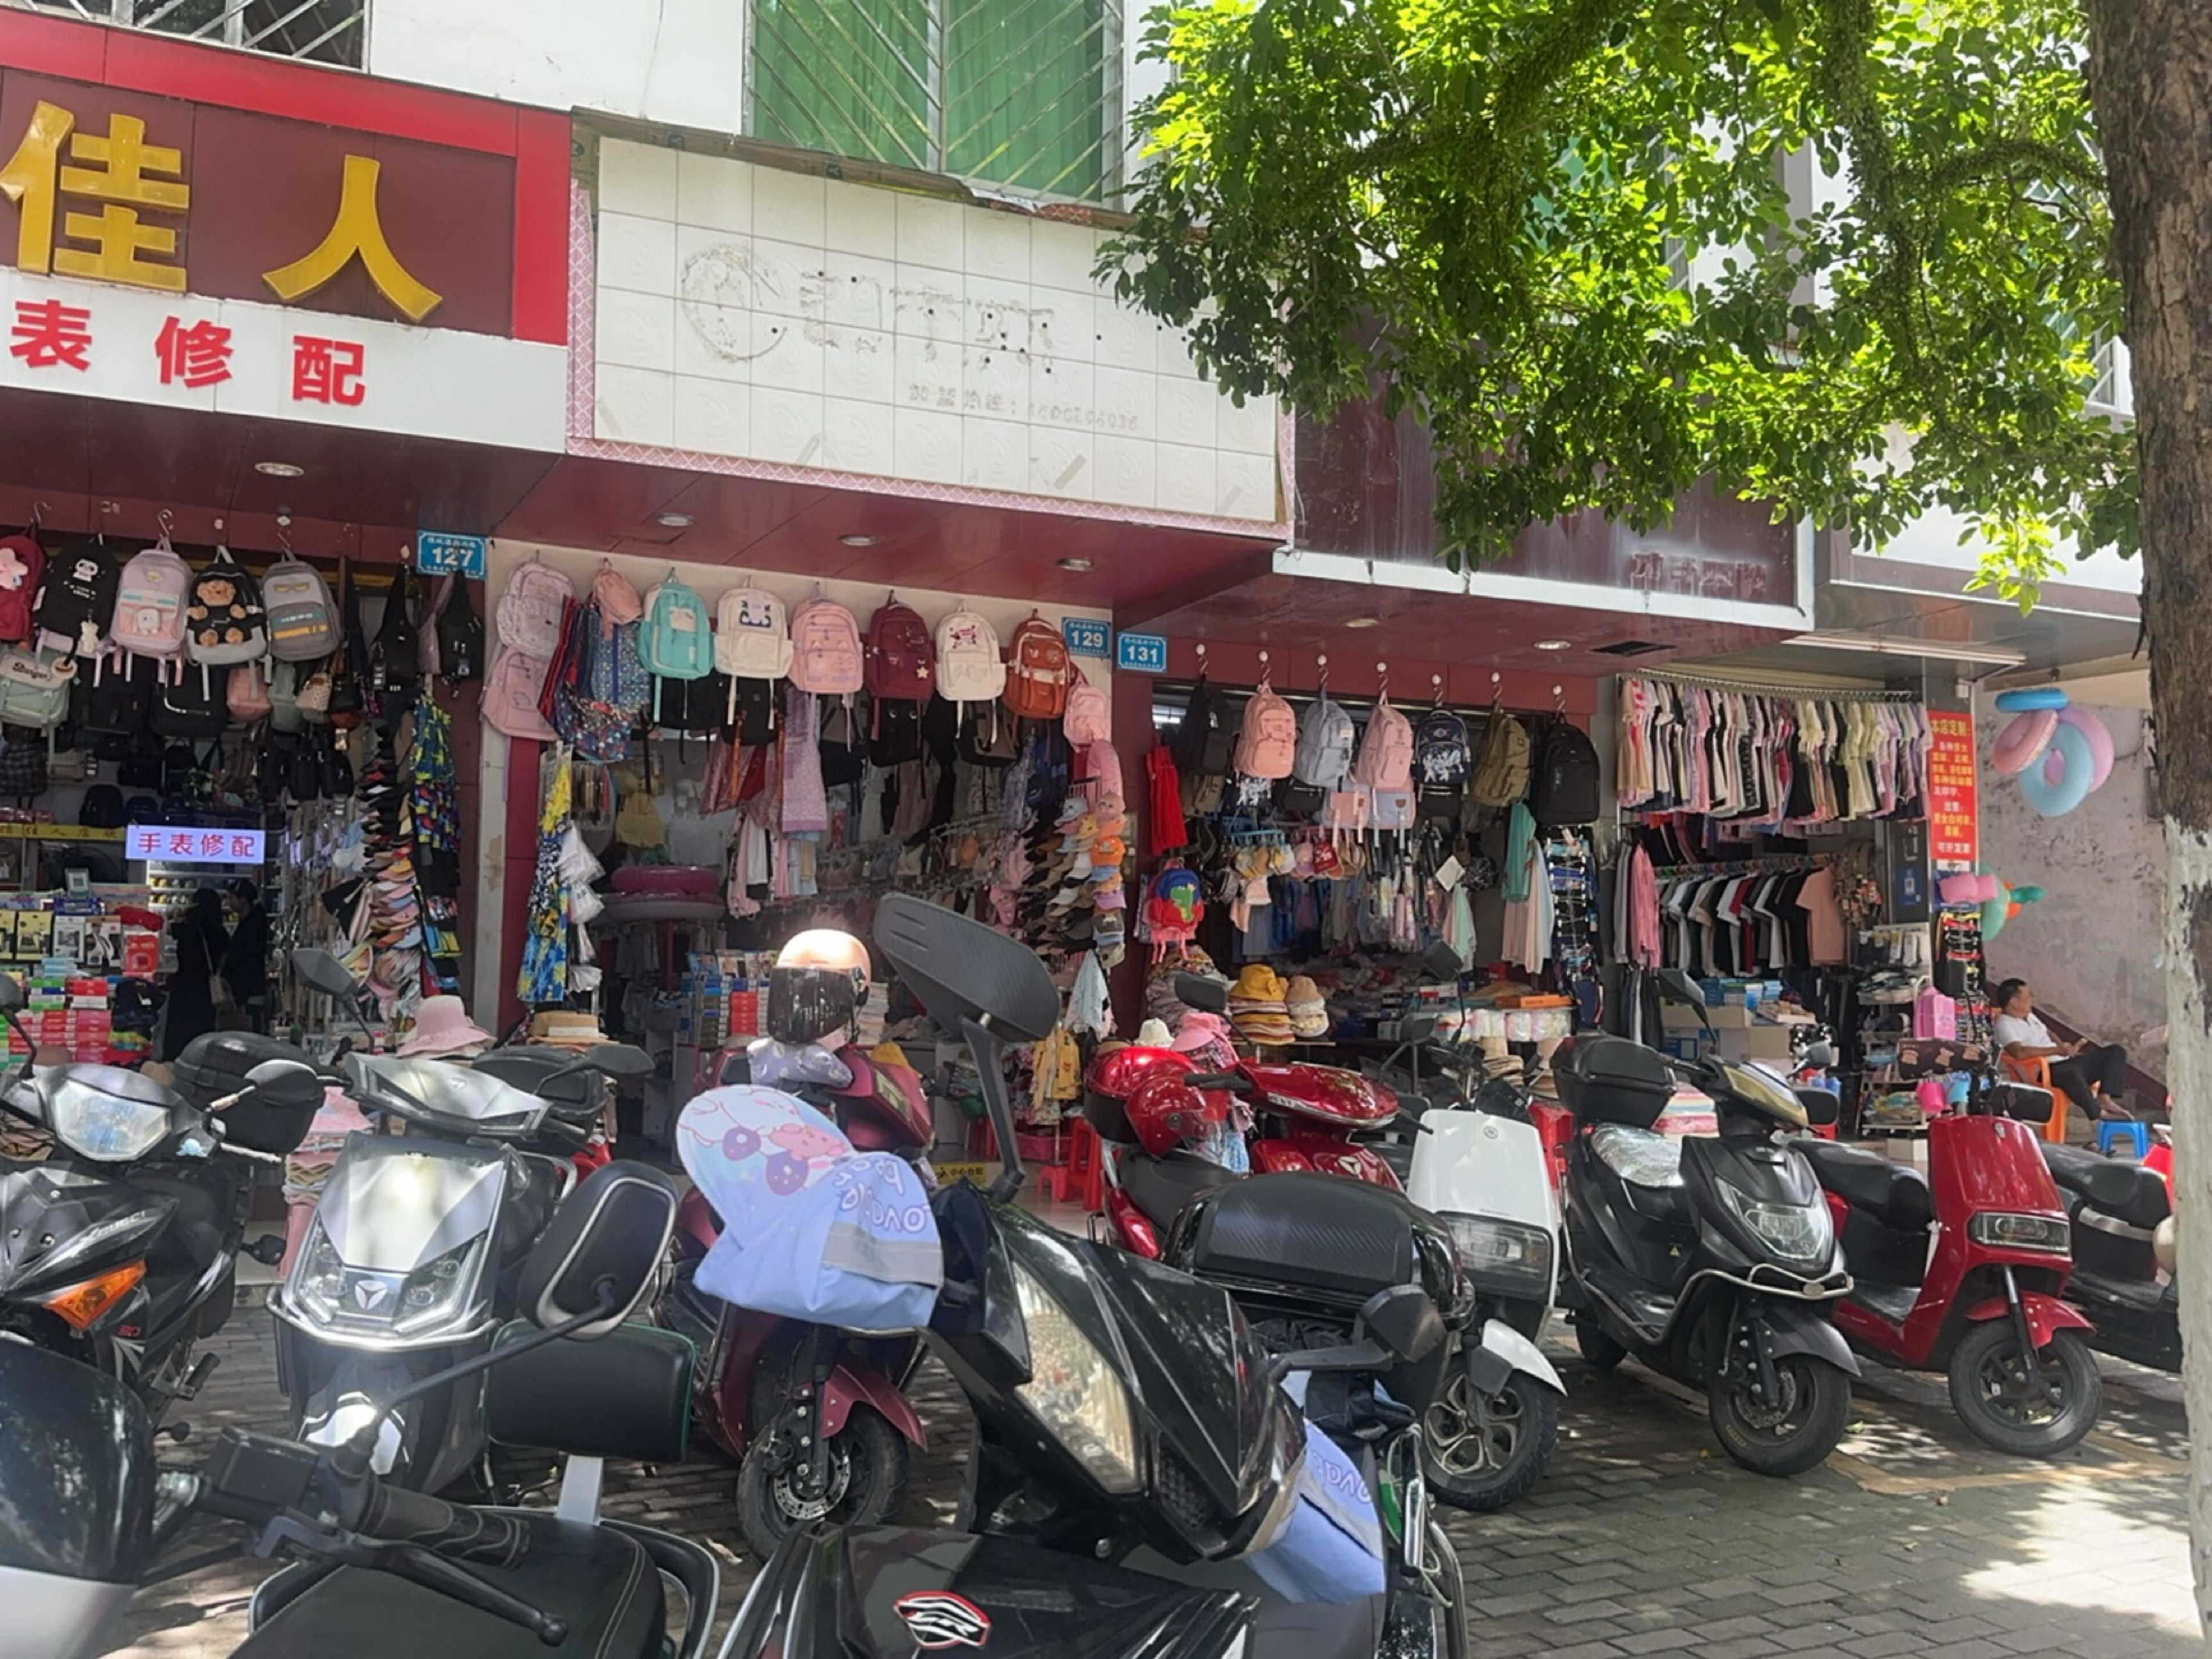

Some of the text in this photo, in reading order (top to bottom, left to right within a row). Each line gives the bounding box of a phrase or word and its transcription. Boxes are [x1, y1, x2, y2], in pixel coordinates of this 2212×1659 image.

[0, 100, 443, 322] 佳人
[10, 299, 365, 406] 表修配
[432, 547, 474, 567] 127
[1071, 630, 1103, 648] 129
[1127, 645, 1158, 663] 131
[137, 832, 255, 858] 手表修配
